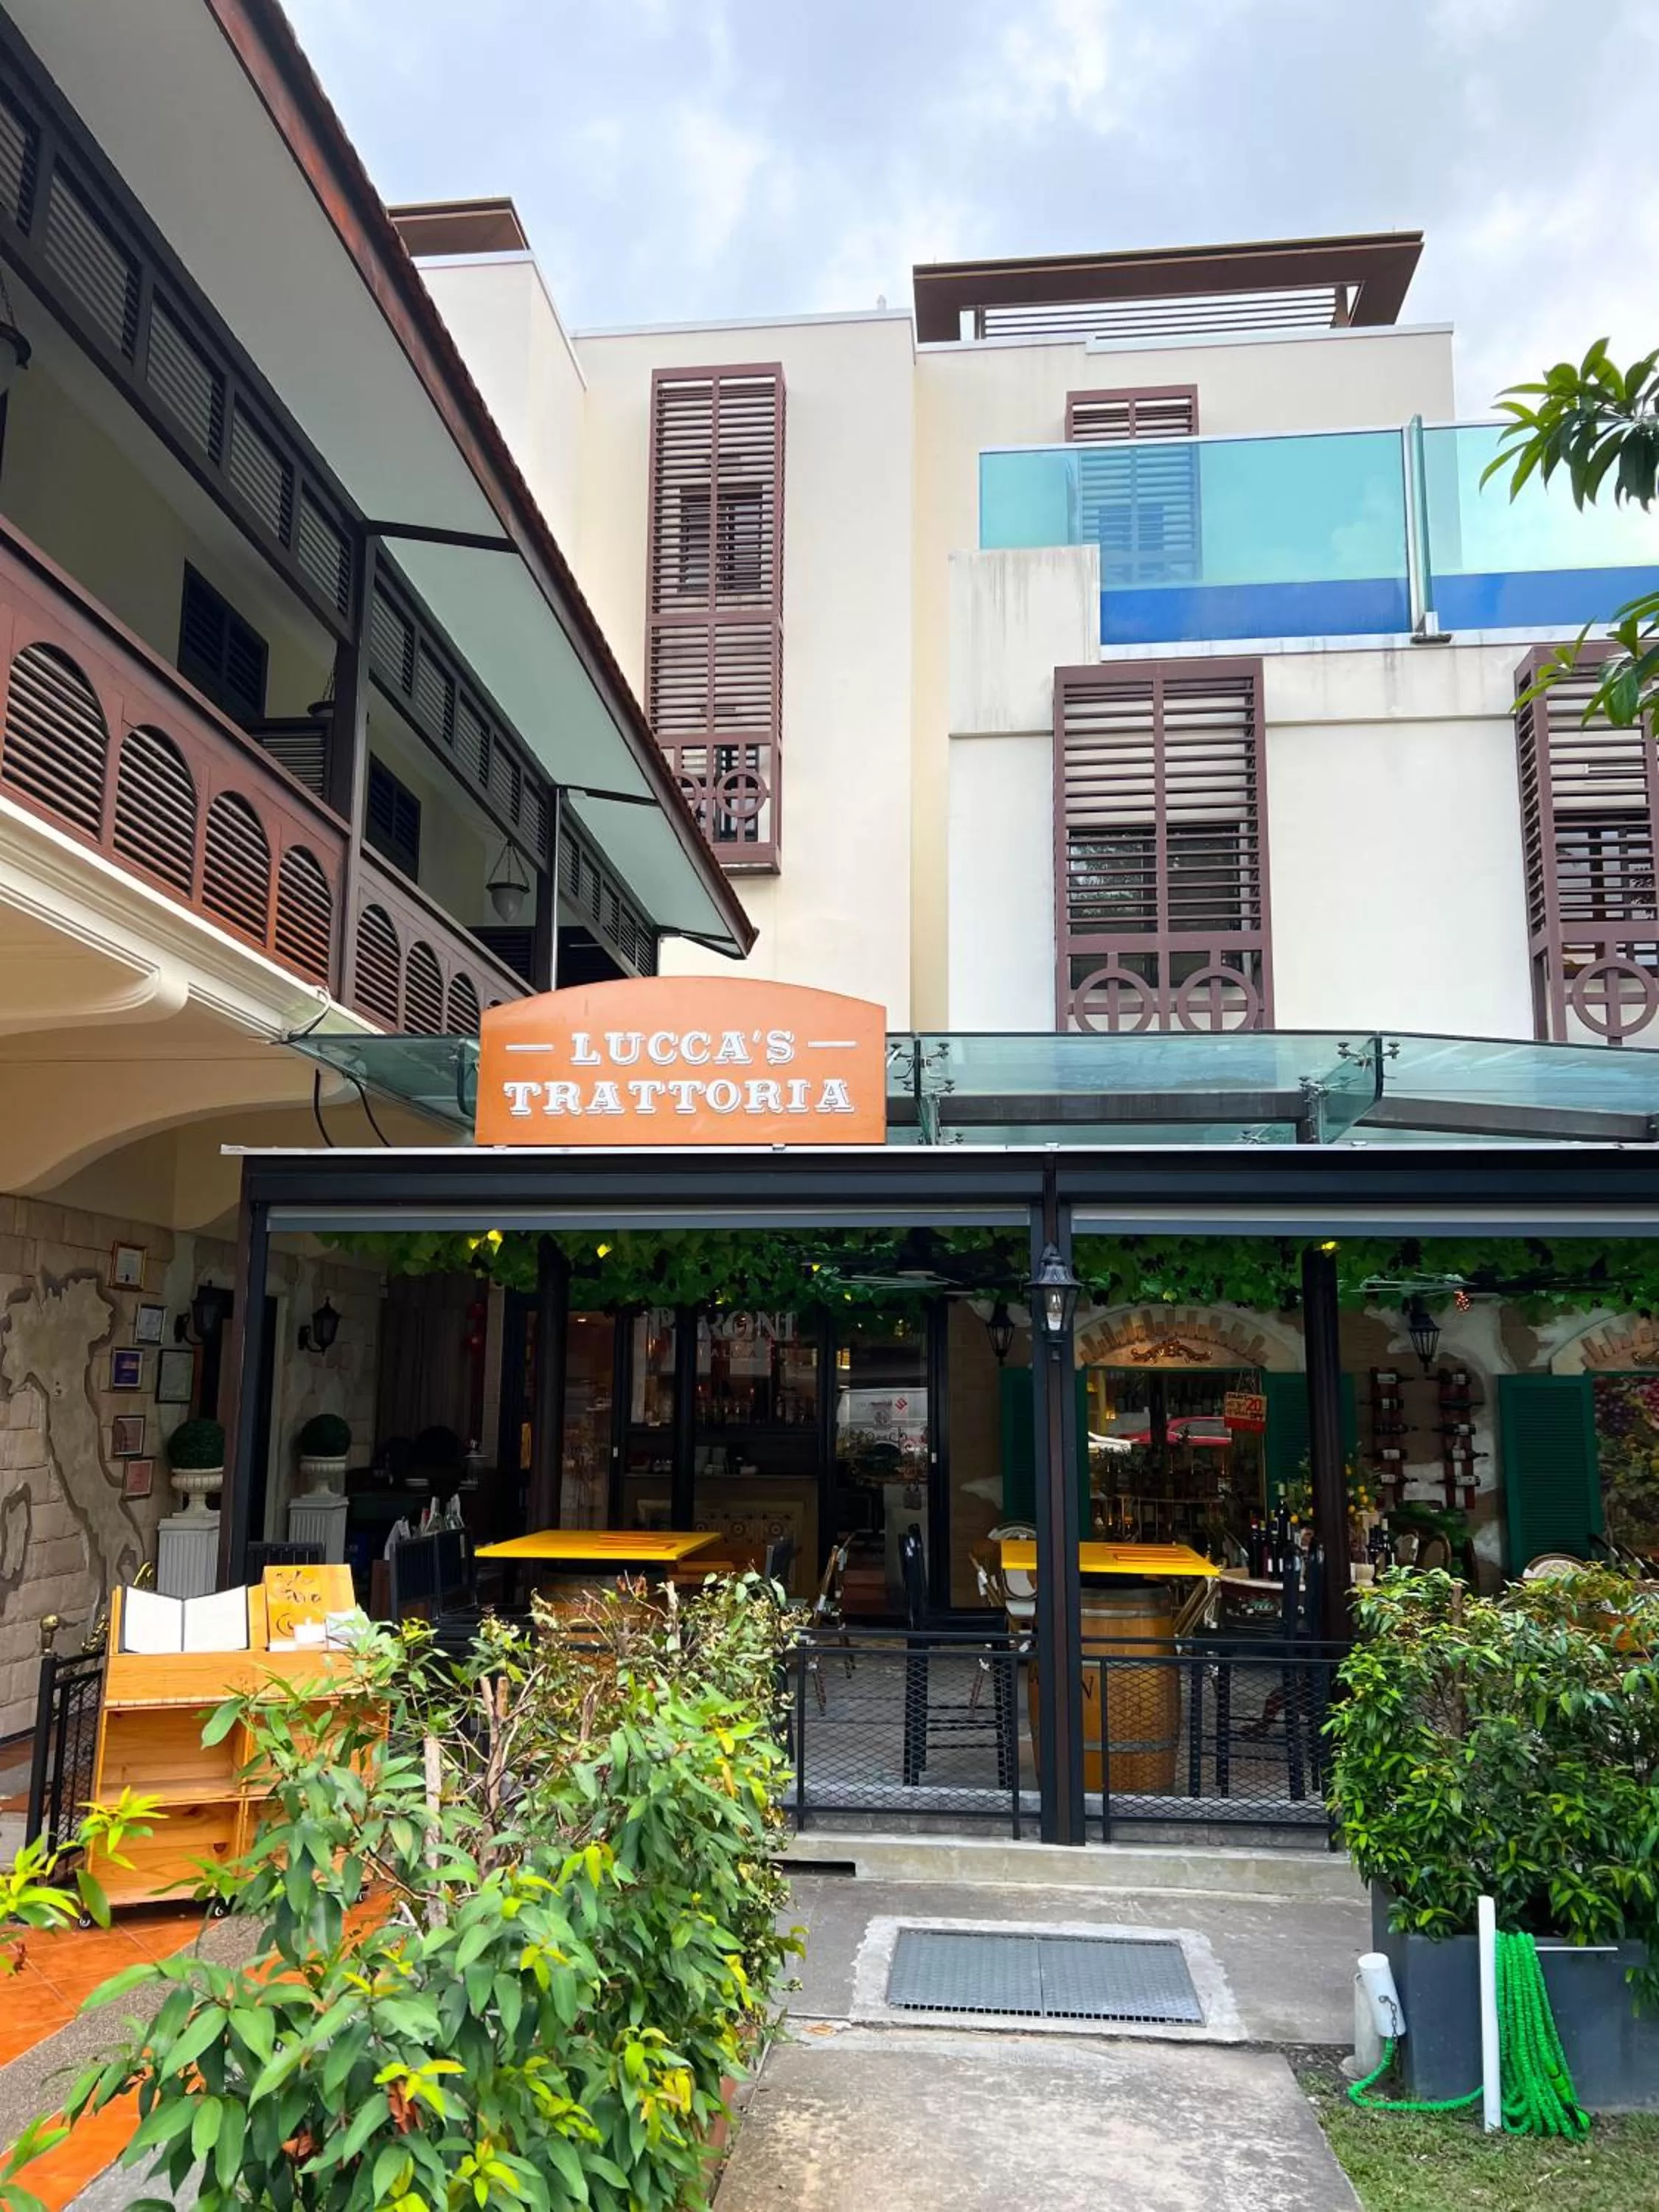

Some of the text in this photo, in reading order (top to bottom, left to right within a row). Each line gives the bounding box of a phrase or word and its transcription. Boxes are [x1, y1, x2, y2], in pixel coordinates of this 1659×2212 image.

[569, 1029, 796, 1066] LUCCA'S
[504, 1079, 855, 1116] TRATTORIA
[649, 1307, 799, 1341] PRONI
